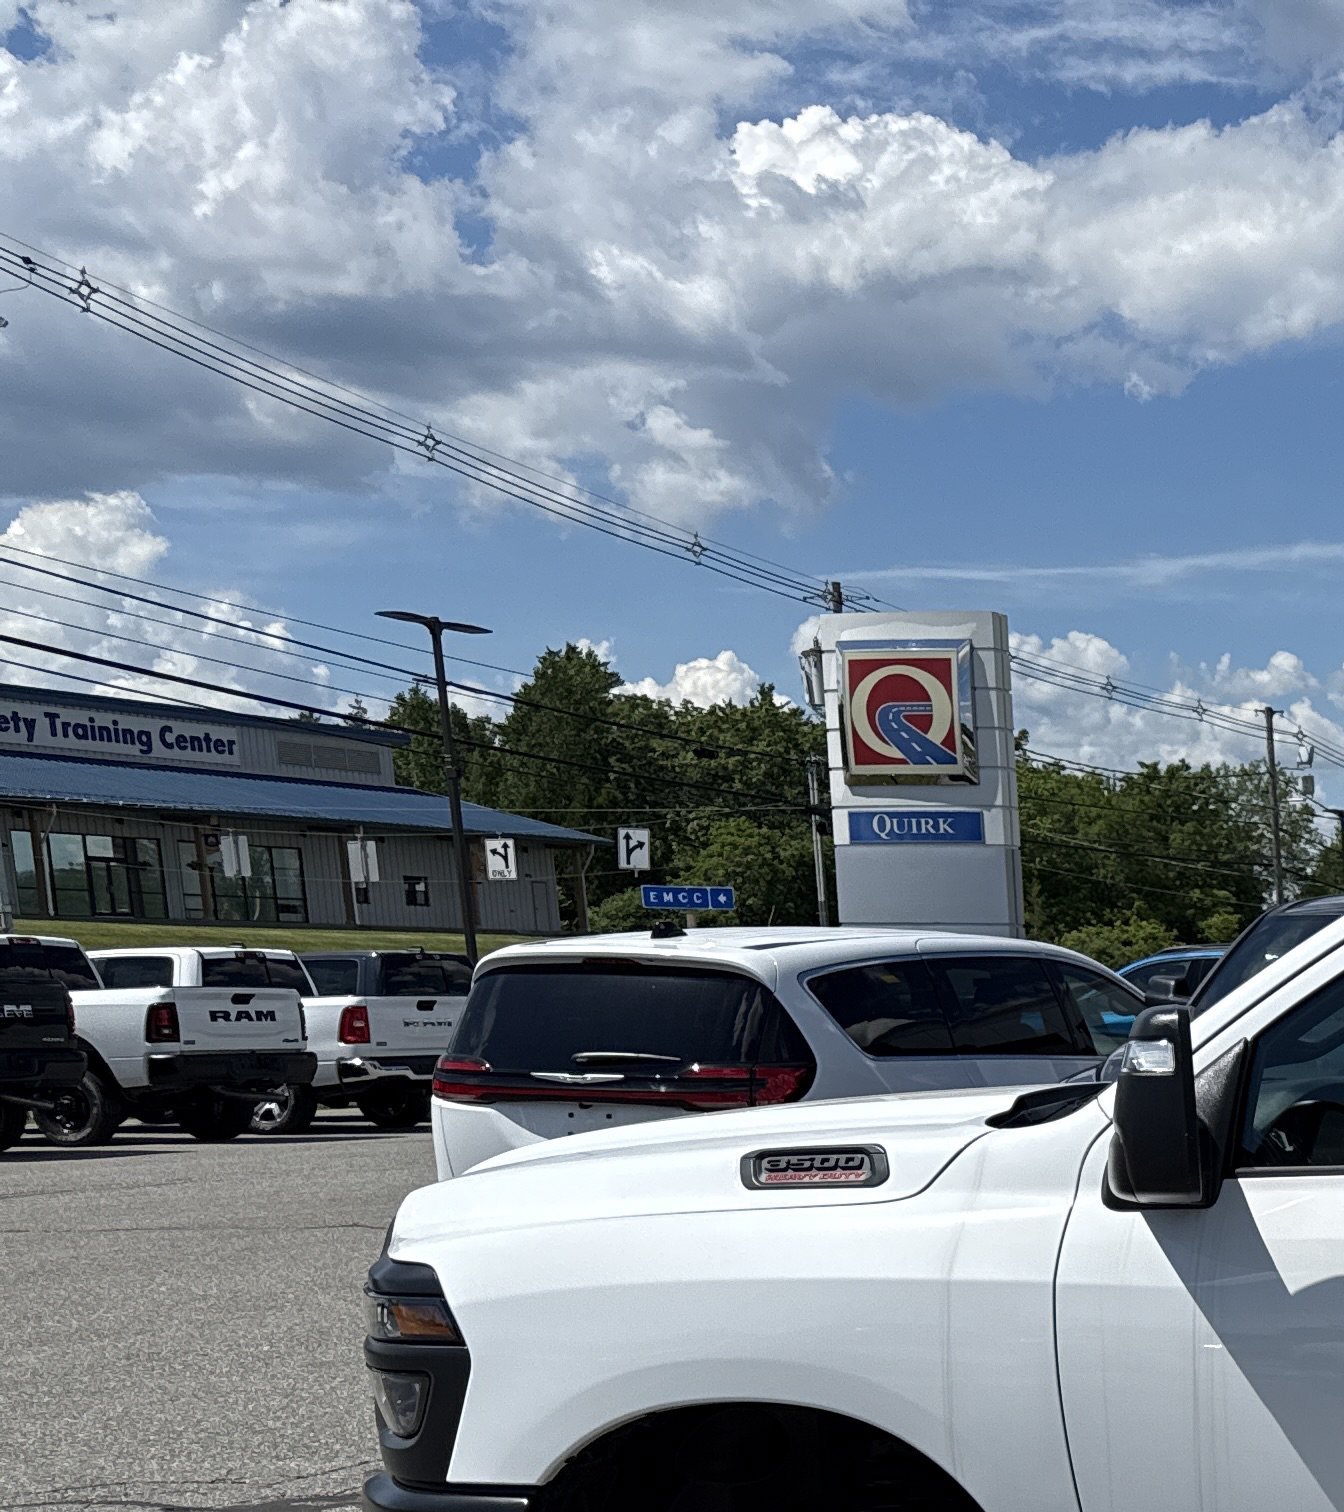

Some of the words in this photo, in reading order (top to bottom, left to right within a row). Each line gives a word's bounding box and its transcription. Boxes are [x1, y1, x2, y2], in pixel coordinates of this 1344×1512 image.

[44, 711, 153, 754] Training
[159, 725, 237, 756] Center
[491, 869, 512, 878] ONLY
[208, 1010, 277, 1022] RAM
[765, 1156, 865, 1173] 3500
